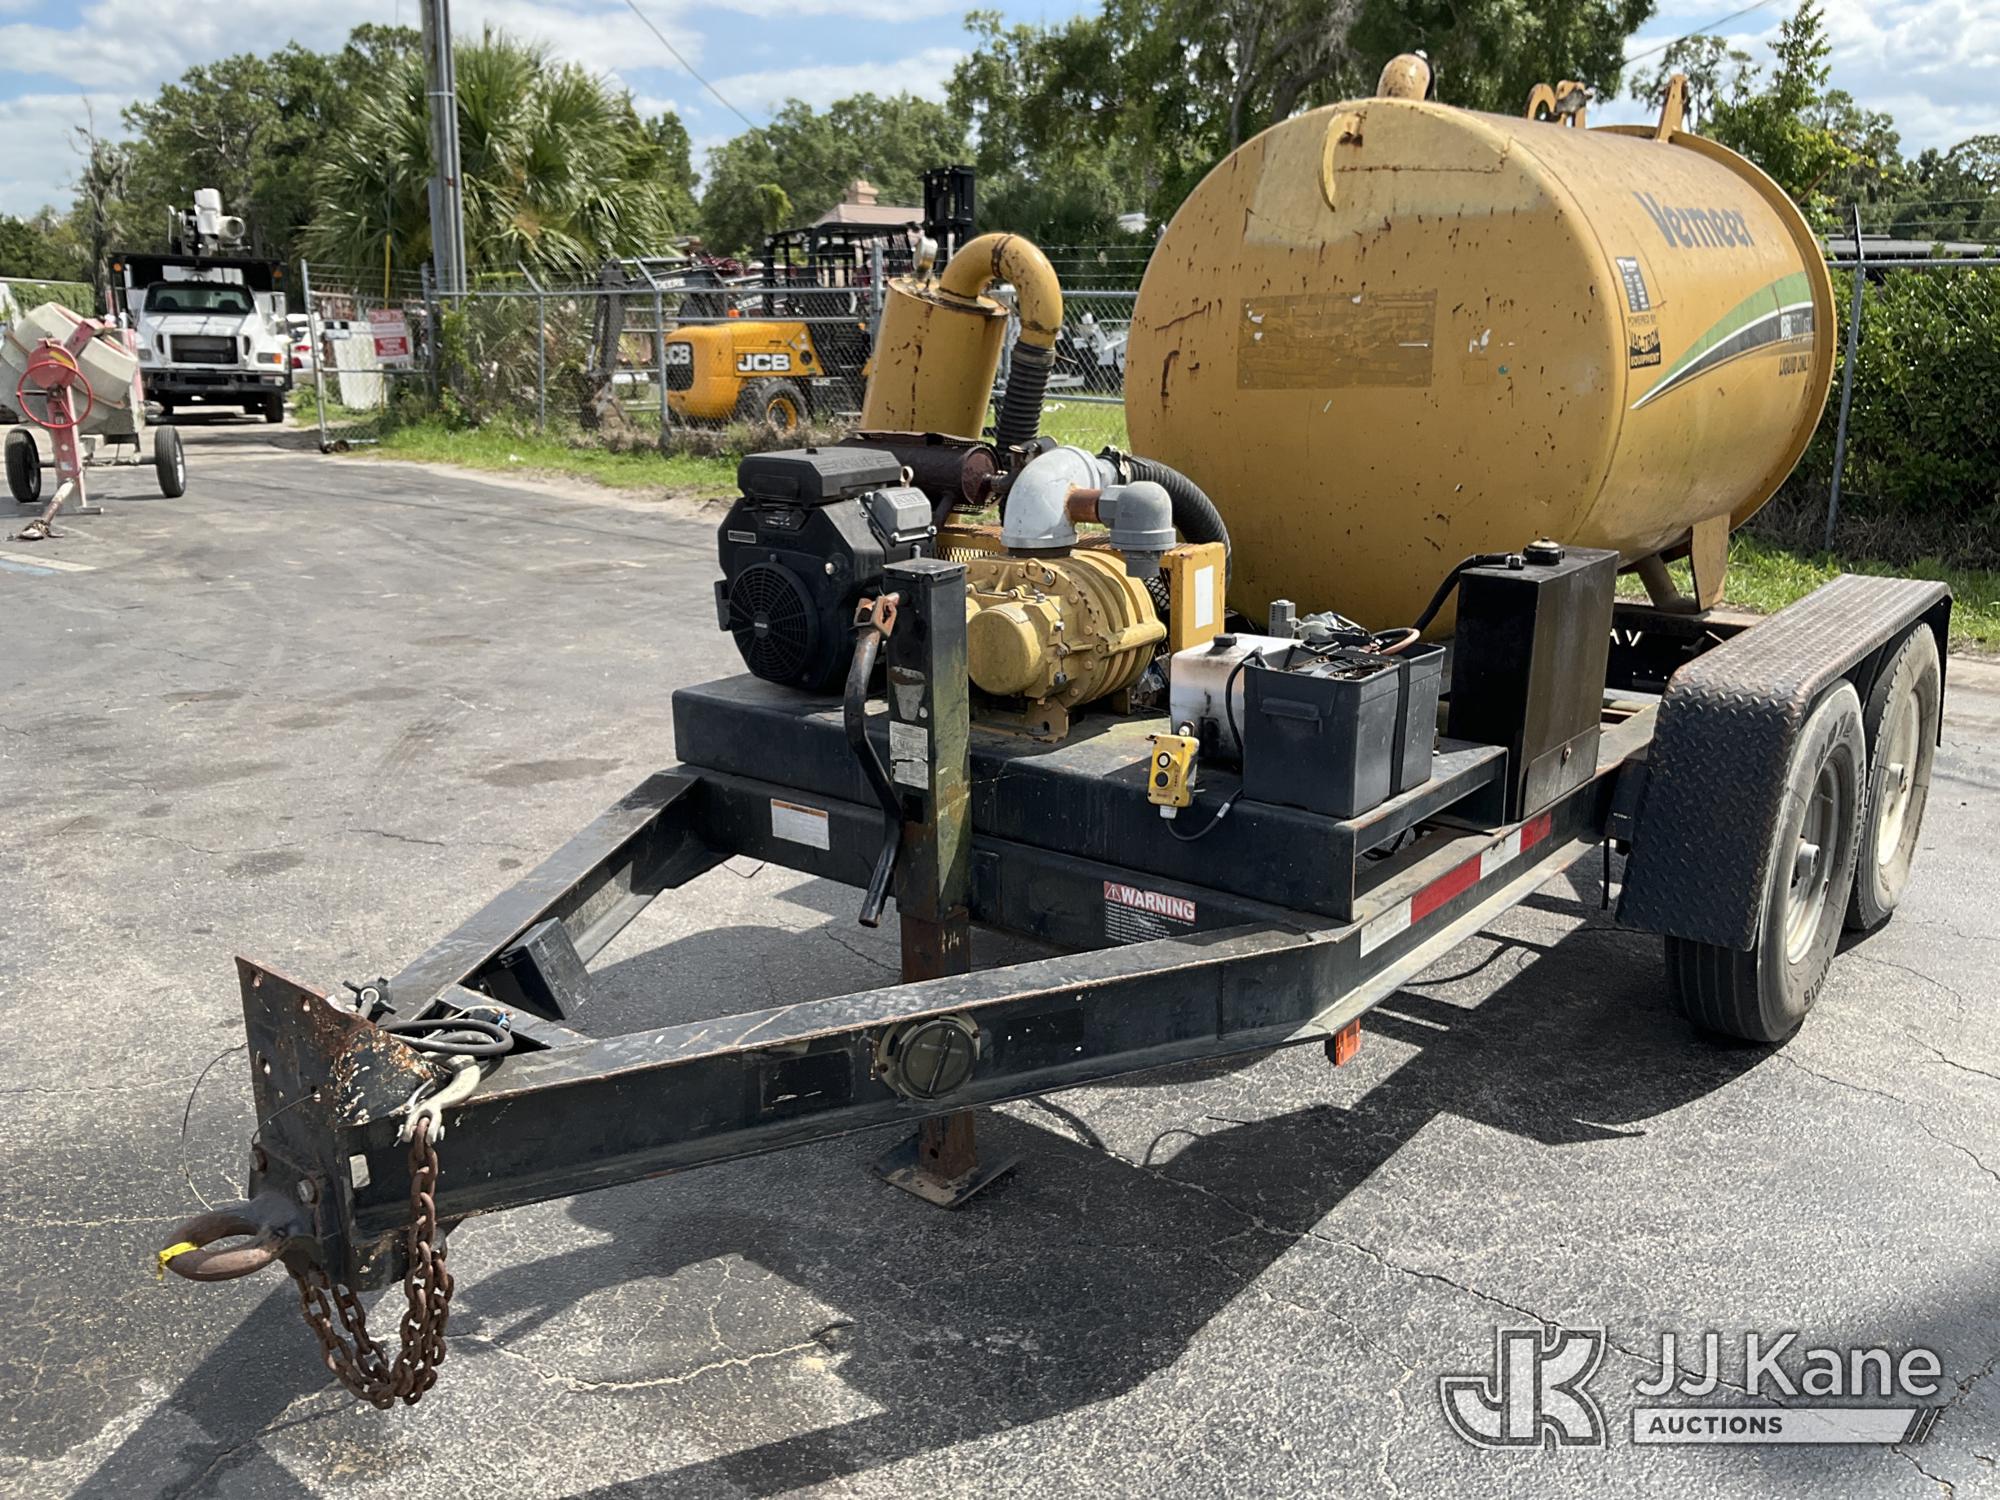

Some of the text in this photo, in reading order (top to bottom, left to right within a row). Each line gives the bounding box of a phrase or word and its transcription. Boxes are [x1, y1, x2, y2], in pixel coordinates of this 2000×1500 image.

[1632, 191, 1755, 248] Vermeer
[737, 354, 790, 371] JCB
[1121, 886, 1196, 920] WARNING
